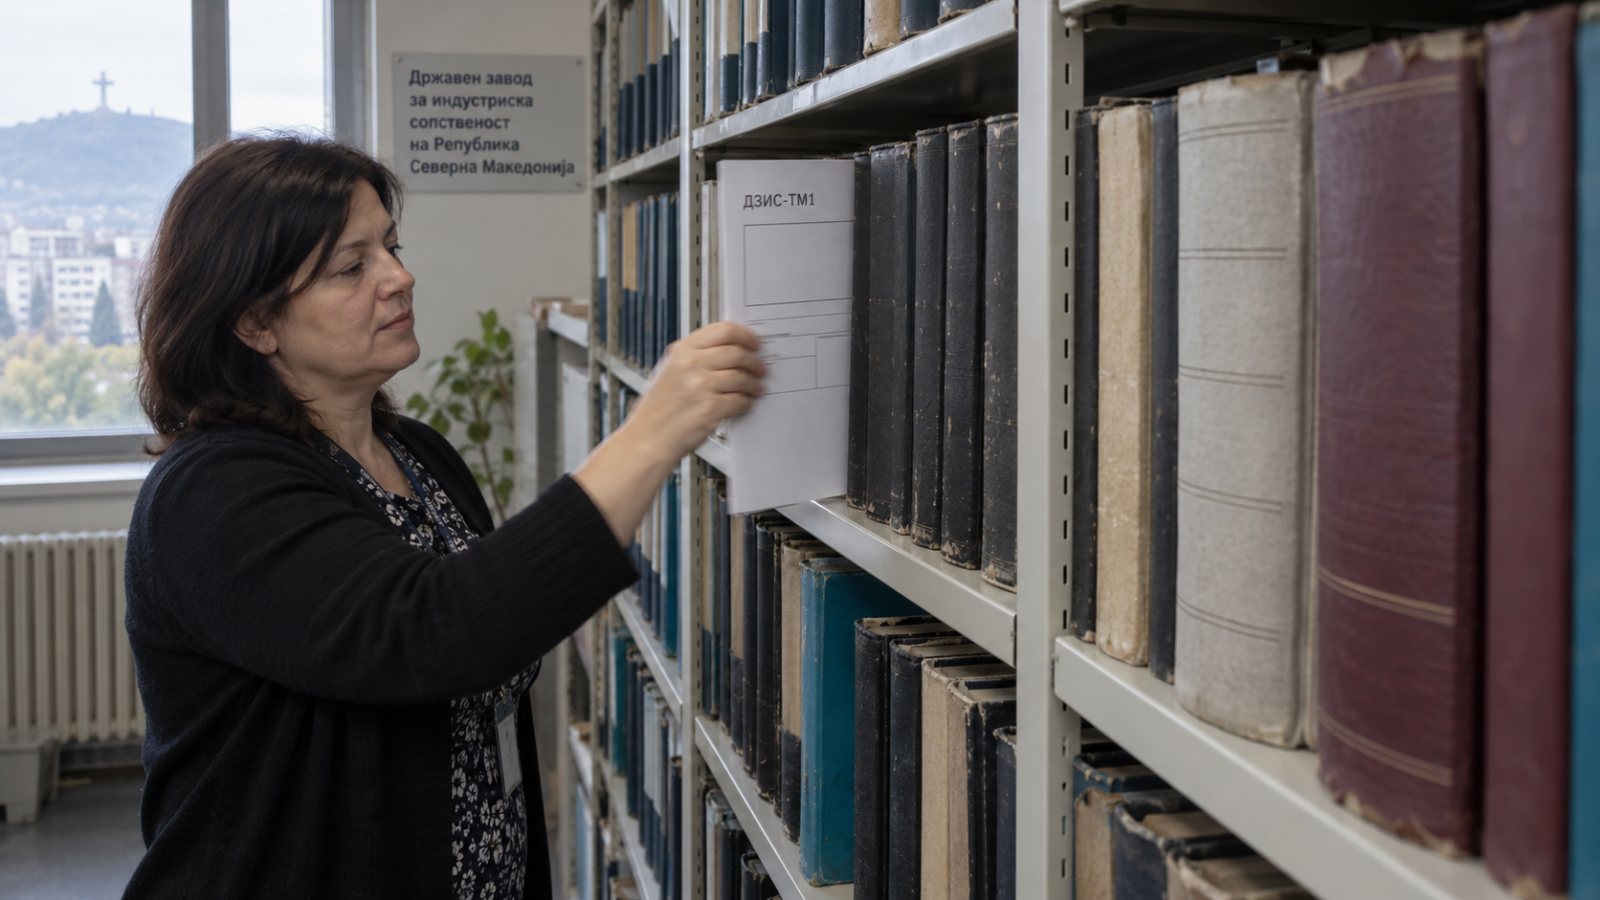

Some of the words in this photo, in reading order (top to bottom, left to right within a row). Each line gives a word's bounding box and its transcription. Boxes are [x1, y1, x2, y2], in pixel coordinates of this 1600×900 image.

[409, 70, 481, 86] Државен
[486, 73, 533, 86] завод
[410, 96, 427, 107] за
[432, 95, 533, 110] индустриска
[410, 117, 510, 129] сопственост
[410, 140, 428, 151] на
[434, 137, 519, 154] Република
[410, 159, 477, 177] Северна
[483, 160, 575, 177] Македонија
[743, 193, 816, 209] ДЗИС-ТМ1
